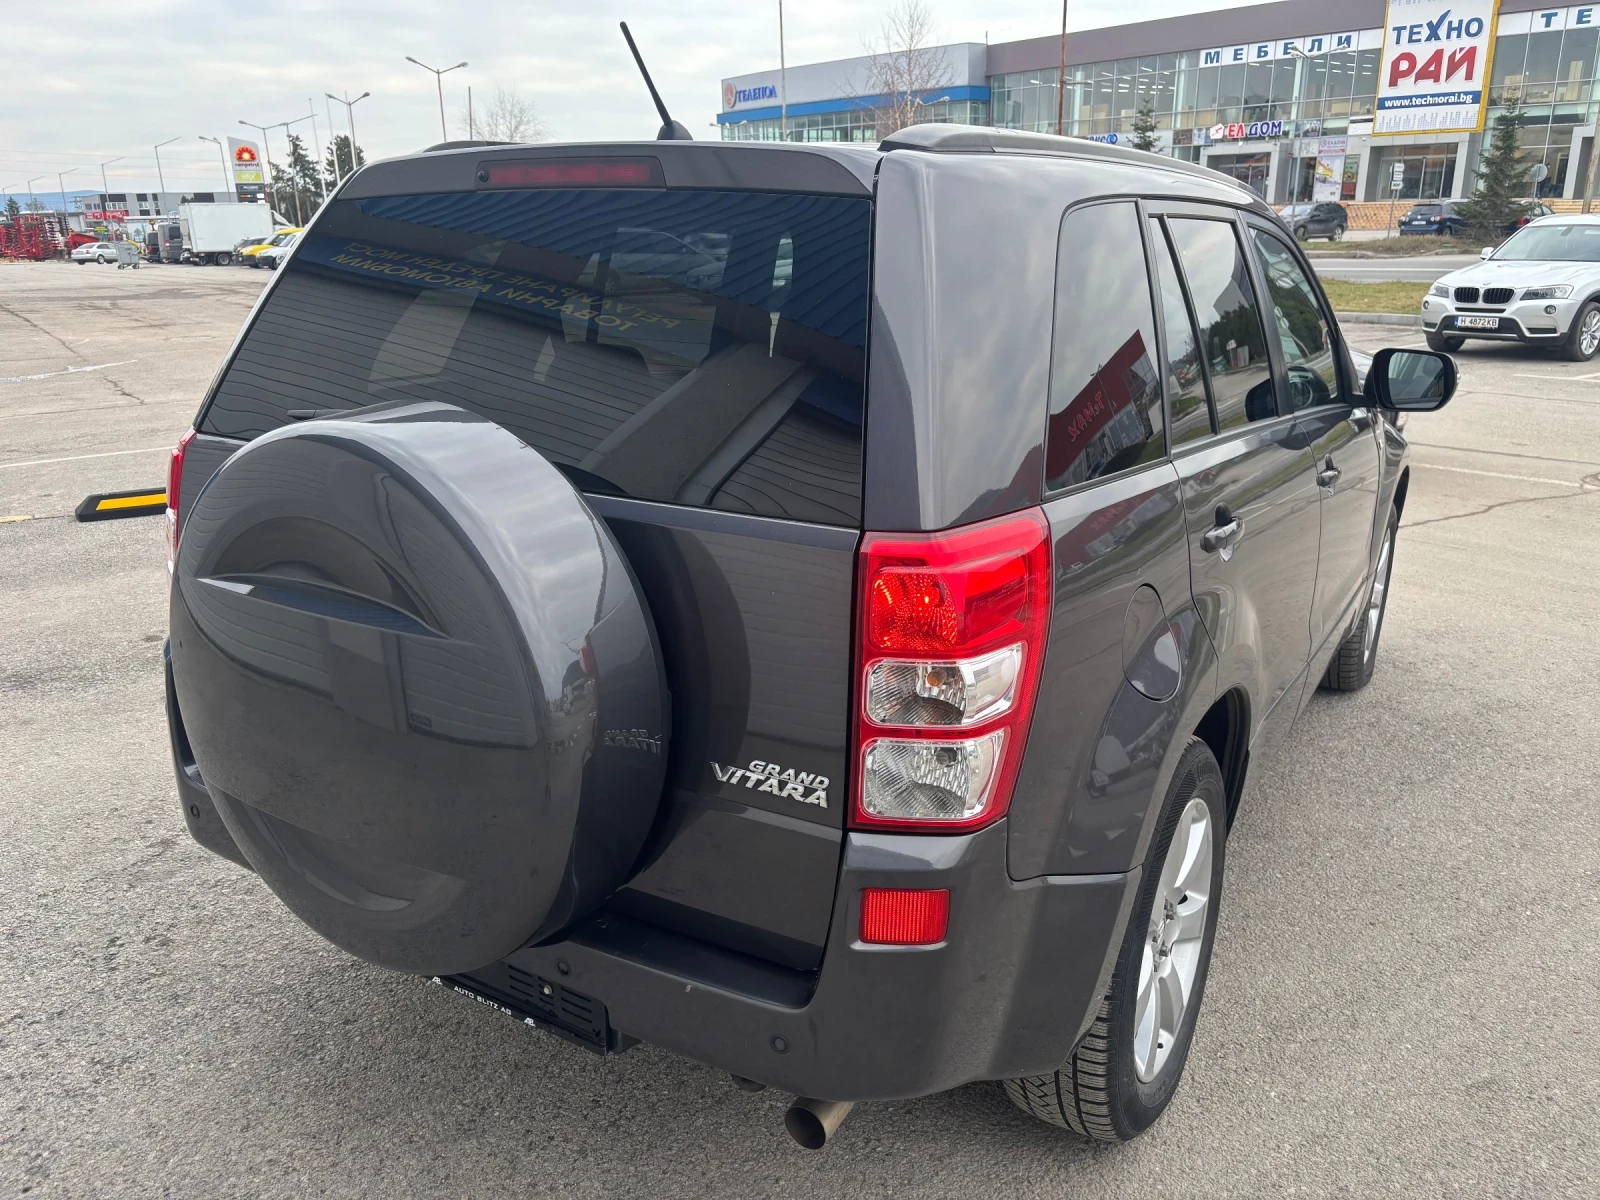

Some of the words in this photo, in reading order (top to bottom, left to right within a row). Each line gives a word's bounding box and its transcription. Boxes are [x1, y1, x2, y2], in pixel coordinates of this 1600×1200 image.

[1392, 9, 1484, 46] ТЕХНО
[1204, 34, 1352, 65] МЕБЕЛИ
[1388, 46, 1478, 88] РАЙ
[1384, 93, 1474, 108] www.technorai.bg
[709, 761, 829, 809] VITARA
[748, 759, 830, 790] GRAND
[453, 985, 475, 999] AUTO
[476, 995, 499, 1010] BLITZ
